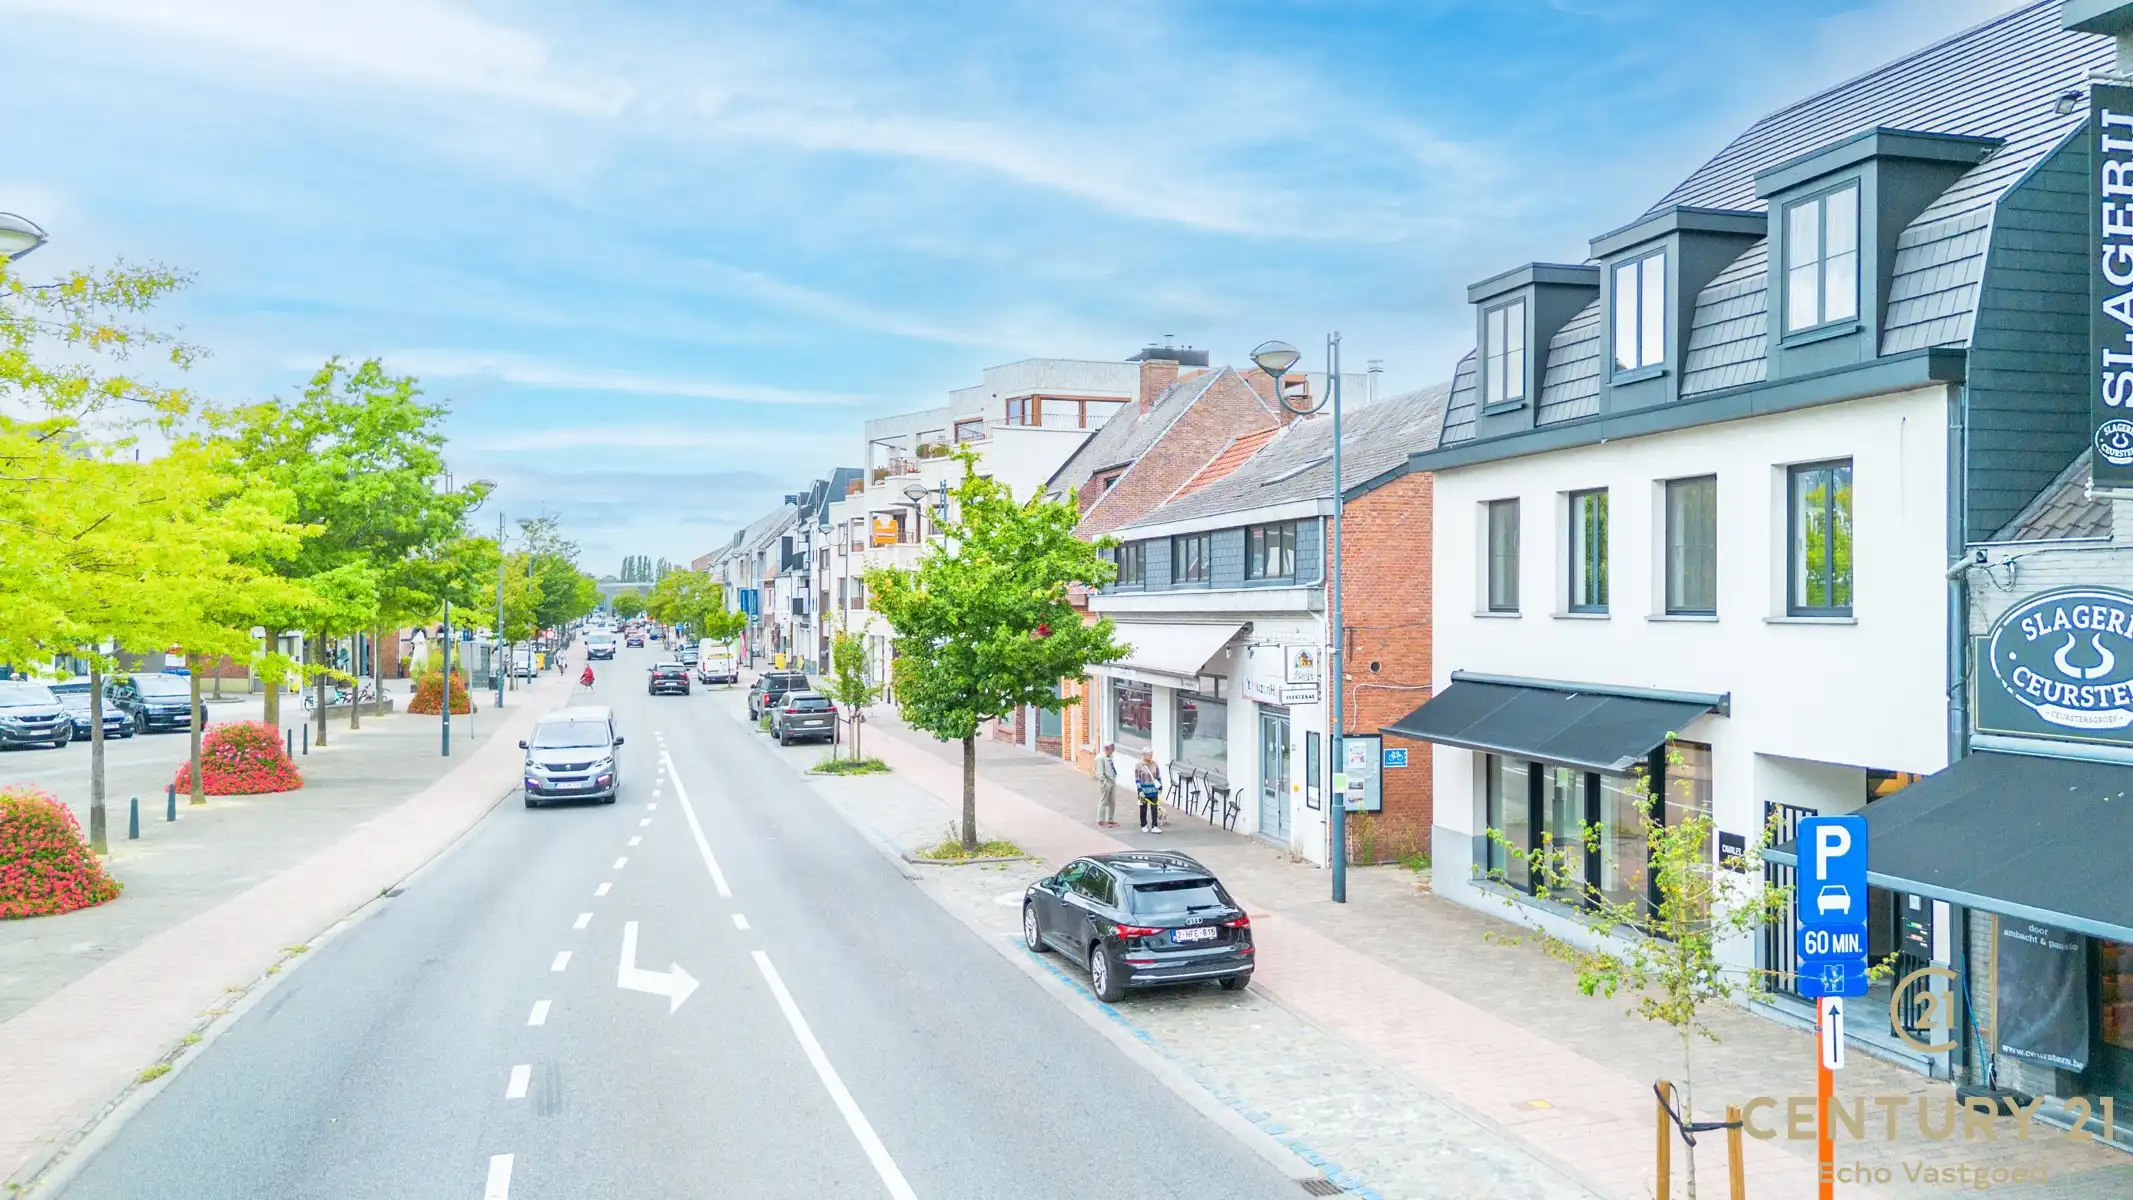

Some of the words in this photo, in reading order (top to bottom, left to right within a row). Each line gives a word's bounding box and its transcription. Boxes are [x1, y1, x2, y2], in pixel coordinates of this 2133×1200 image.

[1815, 825, 1852, 880] P
[2003, 929, 2038, 944] ambacht
[2028, 924, 2049, 936] door
[1804, 930, 1829, 954] 60
[1832, 933, 1863, 953] MIN.
